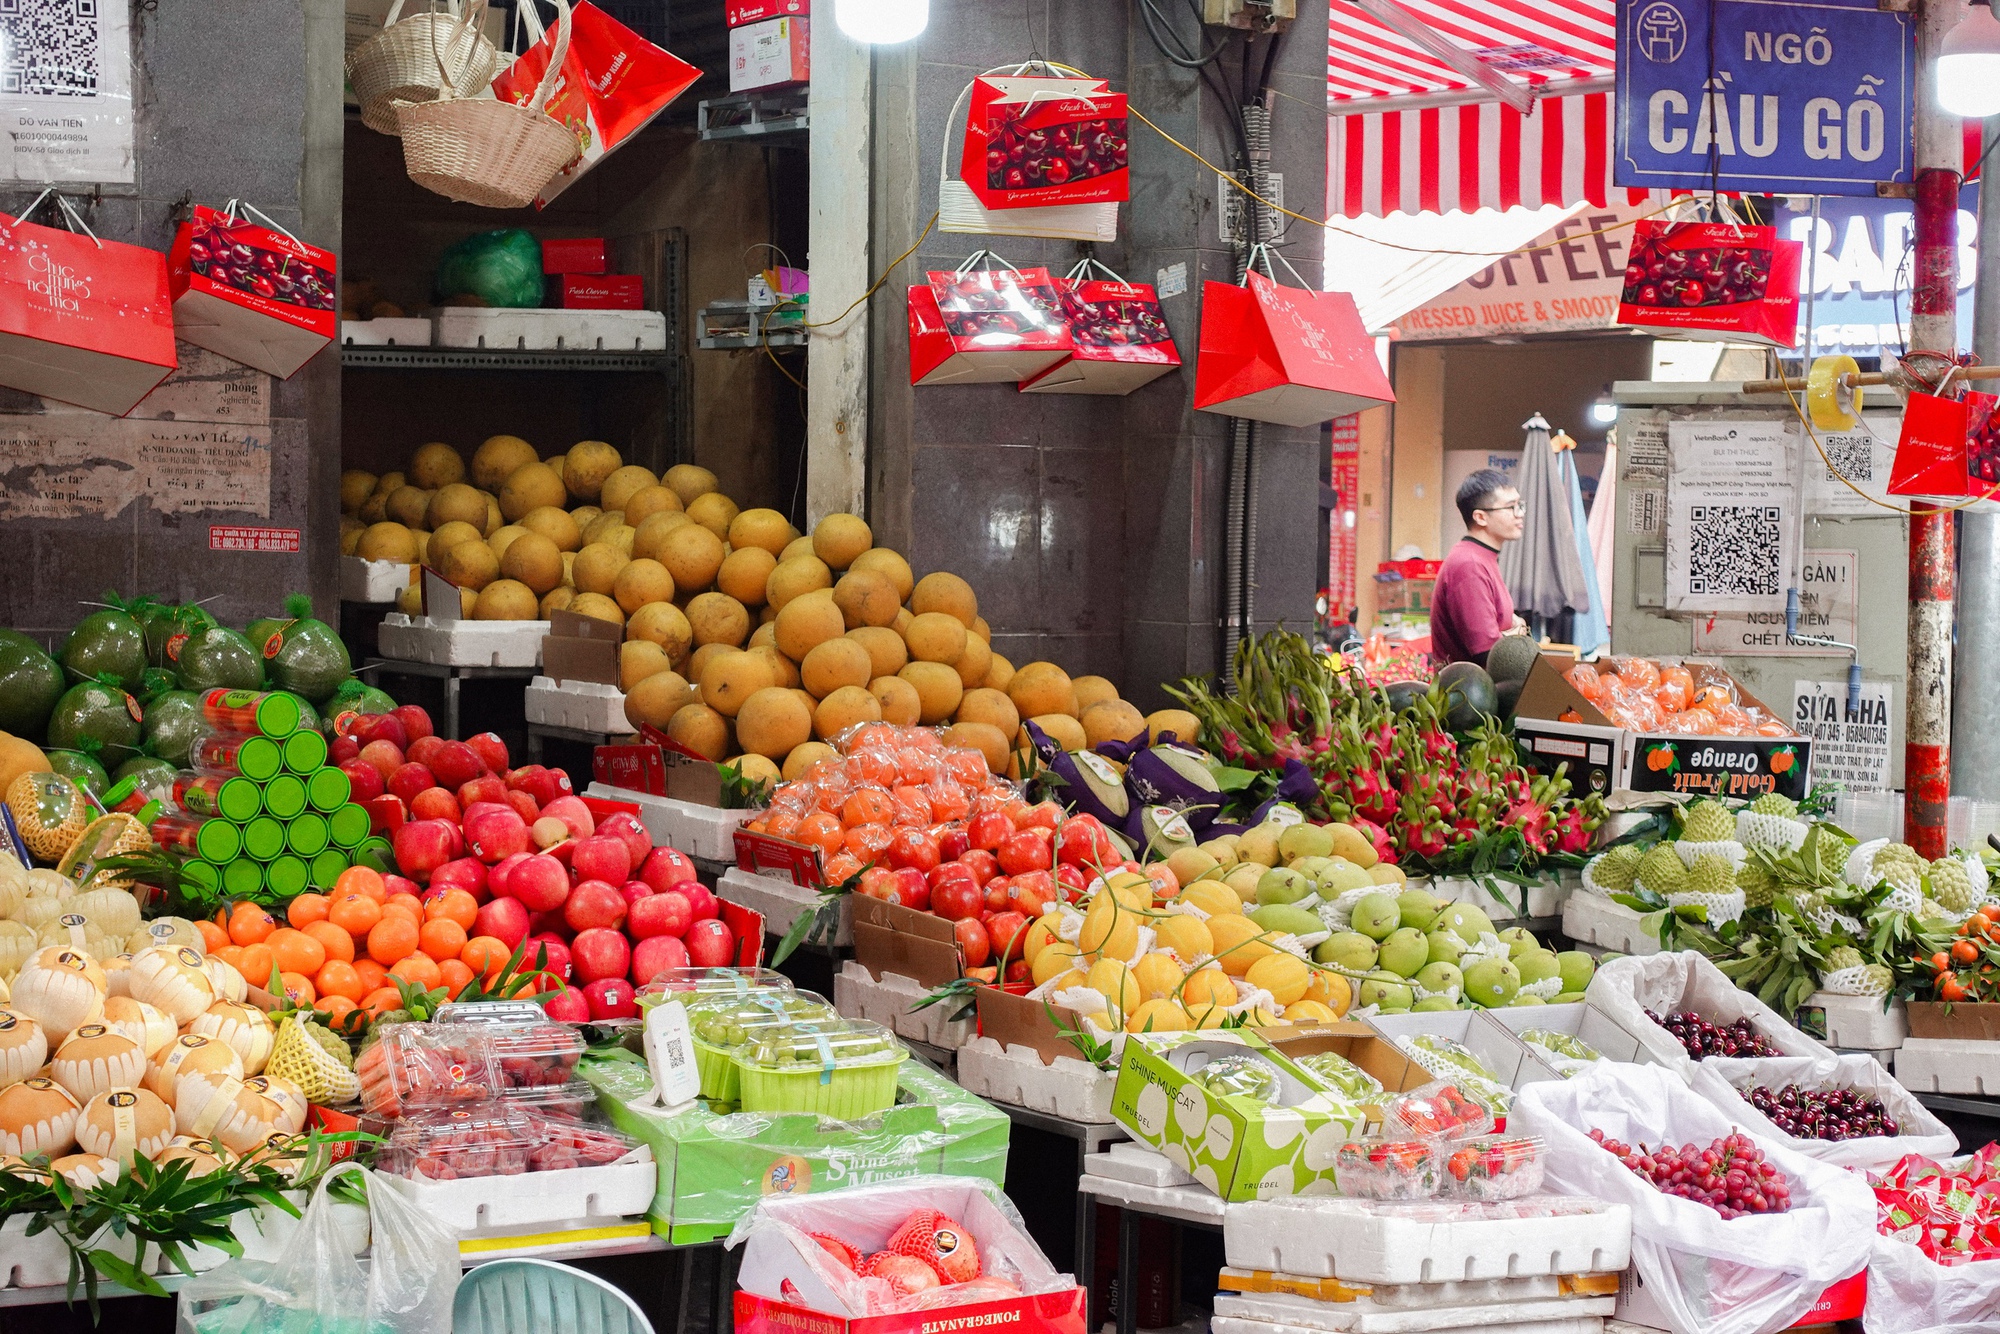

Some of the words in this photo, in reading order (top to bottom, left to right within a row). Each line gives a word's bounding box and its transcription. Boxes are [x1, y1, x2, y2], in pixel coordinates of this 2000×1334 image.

[1744, 26, 1833, 66] NGÕ
[1058, 101, 1080, 112] Fresh
[1648, 70, 1780, 158] CẦU
[1803, 74, 1886, 162] GỖ
[37, 119, 58, 127] VAN
[60, 119, 83, 128] TIEN
[266, 233, 290, 248] Fresh
[1703, 227, 1726, 237] Fresh
[568, 286, 584, 294] Fresh
[586, 287, 609, 296] Cherries
[1481, 300, 1528, 325] JUICE
[1534, 300, 1549, 320] &
[212, 537, 222, 548] TEL:
[1796, 684, 1838, 722] SỬA
[1691, 746, 1759, 772] Orange
[1729, 772, 1776, 794] Gold
[1129, 1057, 1156, 1084] SHINE
[1156, 1080, 1196, 1113] MUSCAT
[1120, 1100, 1151, 1129] TRUEDEL
[826, 1154, 888, 1182] Shine
[847, 1167, 921, 1187] Muscat
[1243, 1181, 1280, 1191] TRUEDEL
[1108, 1279, 1119, 1316] Apple
[922, 1310, 1021, 1334] POMEGRANATE
